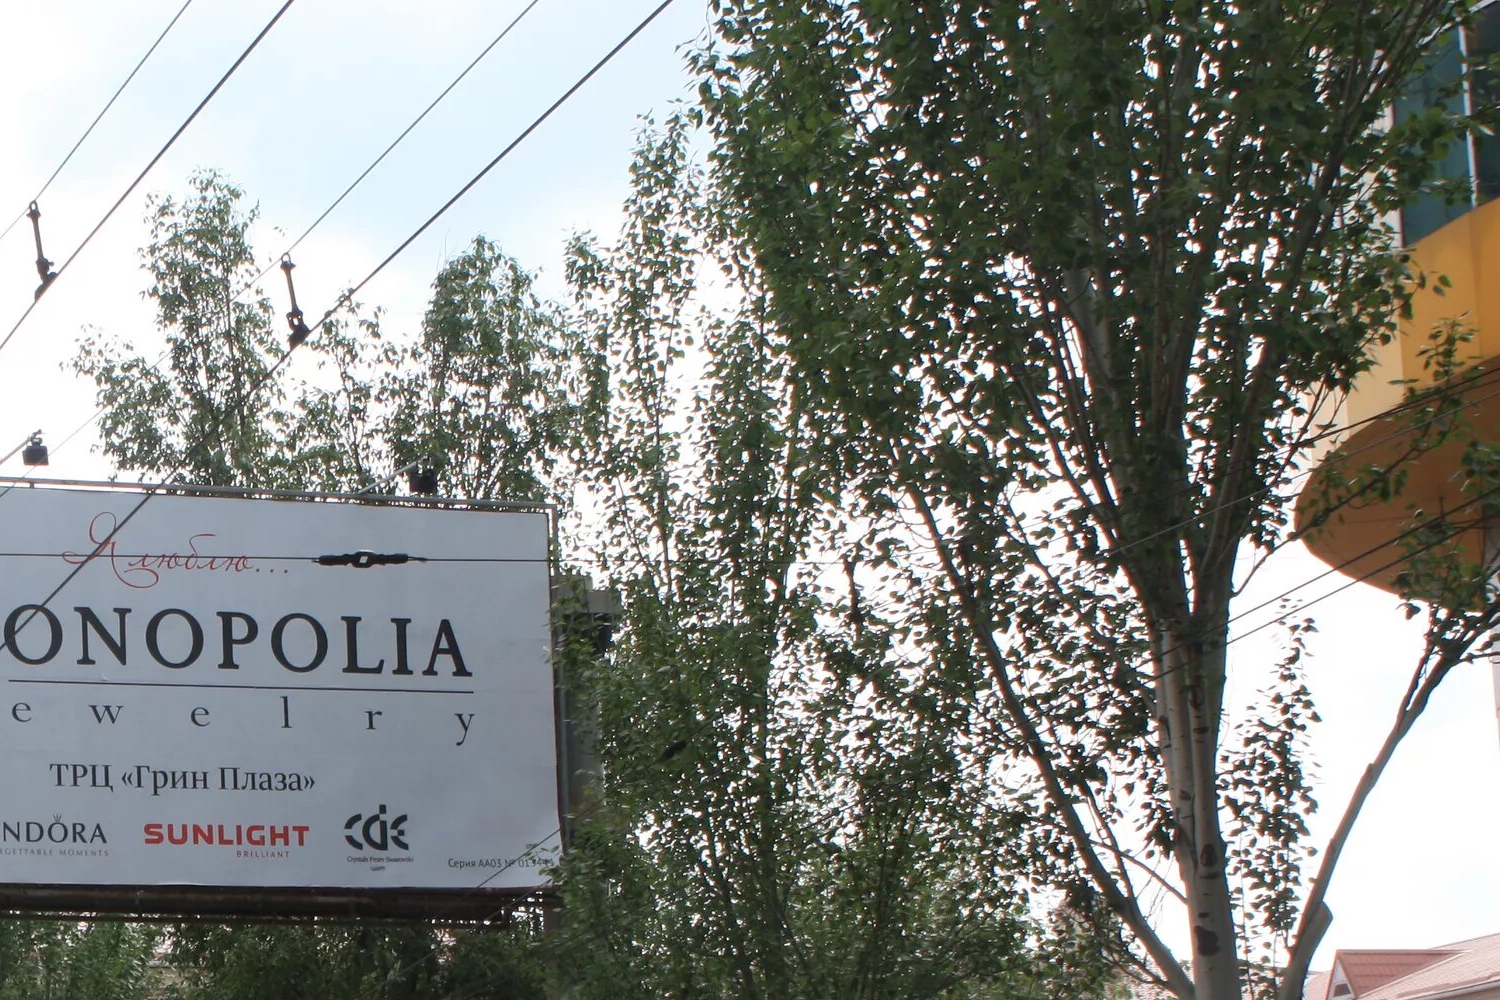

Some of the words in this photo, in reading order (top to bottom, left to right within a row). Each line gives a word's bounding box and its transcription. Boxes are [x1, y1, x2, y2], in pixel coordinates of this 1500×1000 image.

[61, 511, 159, 589] Я
[49, 763, 115, 792] ТРЦ
[120, 766, 210, 796] «Грин
[217, 767, 316, 792] Плаза»
[143, 823, 311, 847] SUNLIGHT
[58, 848, 110, 858] MOMENTS
[236, 850, 291, 859] BRILLIANT
[447, 857, 476, 870] Серия
